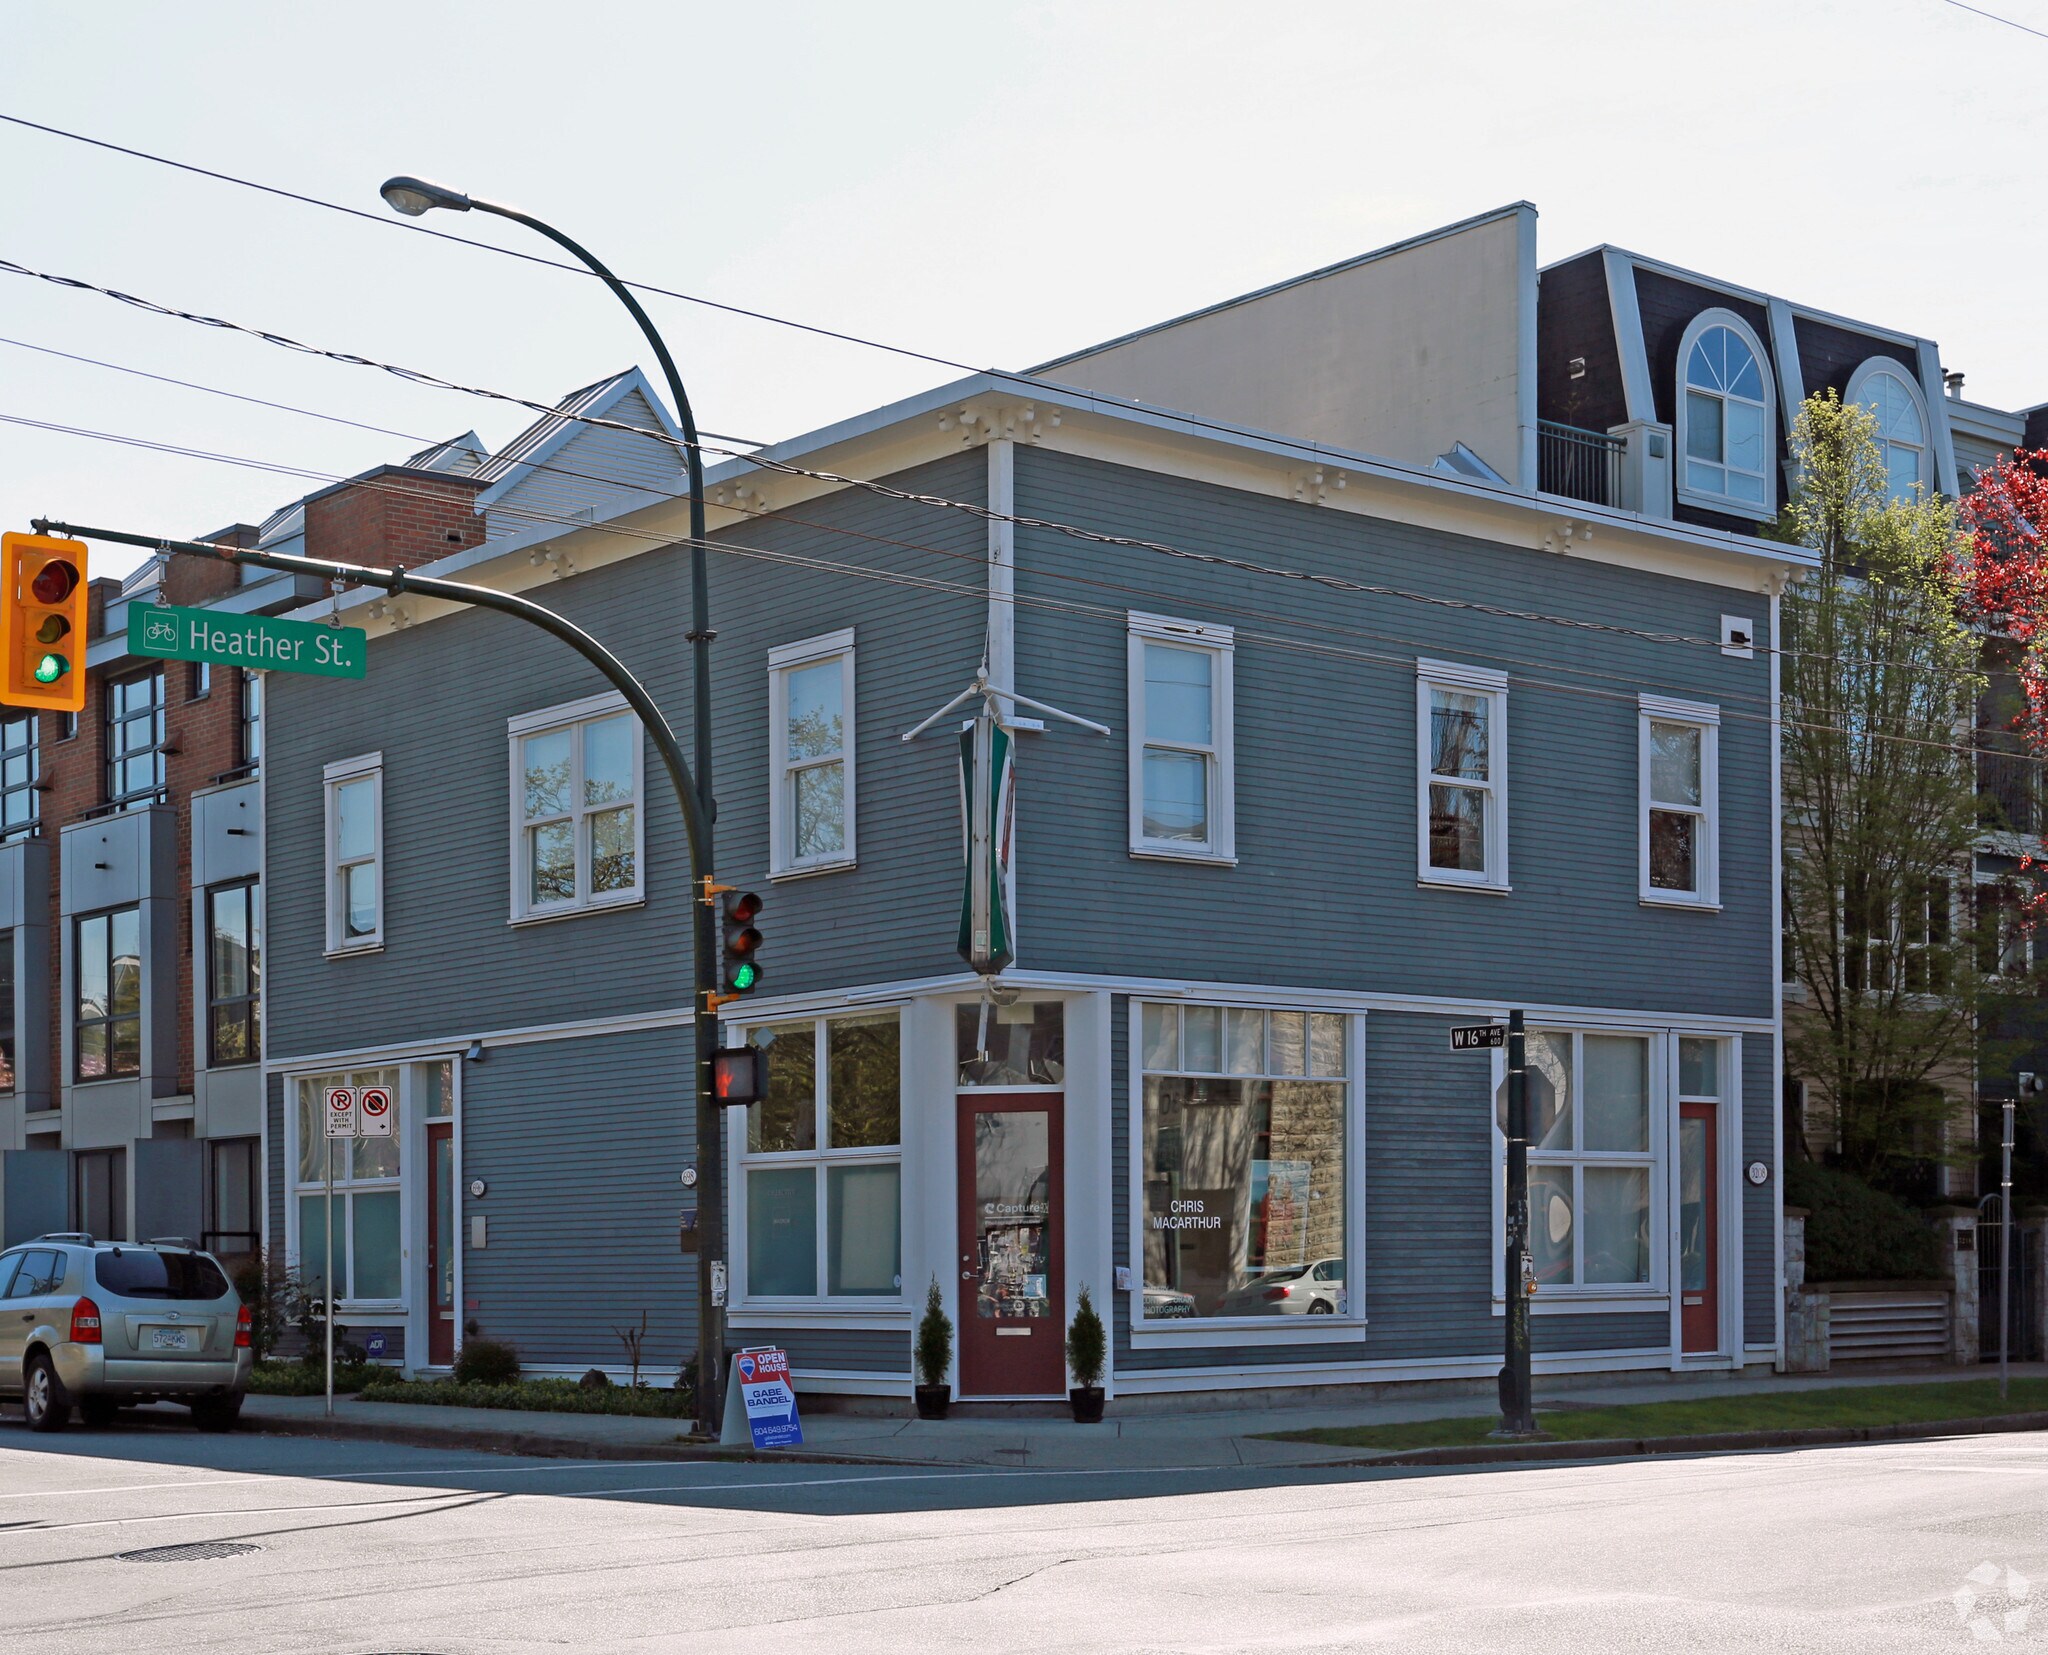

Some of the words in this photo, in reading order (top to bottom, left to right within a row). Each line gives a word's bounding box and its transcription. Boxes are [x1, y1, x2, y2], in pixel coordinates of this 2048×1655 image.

[190, 620, 304, 661] Heather
[314, 634, 352, 667] St.
[1454, 1031, 1464, 1046] W
[1490, 1028, 1501, 1036] AVE
[1490, 1037, 1501, 1045] 600
[996, 1203, 1040, 1214] Capture
[1170, 1200, 1204, 1213] CHRIS
[1153, 1216, 1221, 1229] MACARTHUR
[369, 1339, 384, 1349] ADT
[757, 1352, 786, 1365] OPEN
[759, 1362, 788, 1374] HOUSE
[752, 1387, 783, 1398] GABE
[747, 1396, 791, 1407] BANDEL
